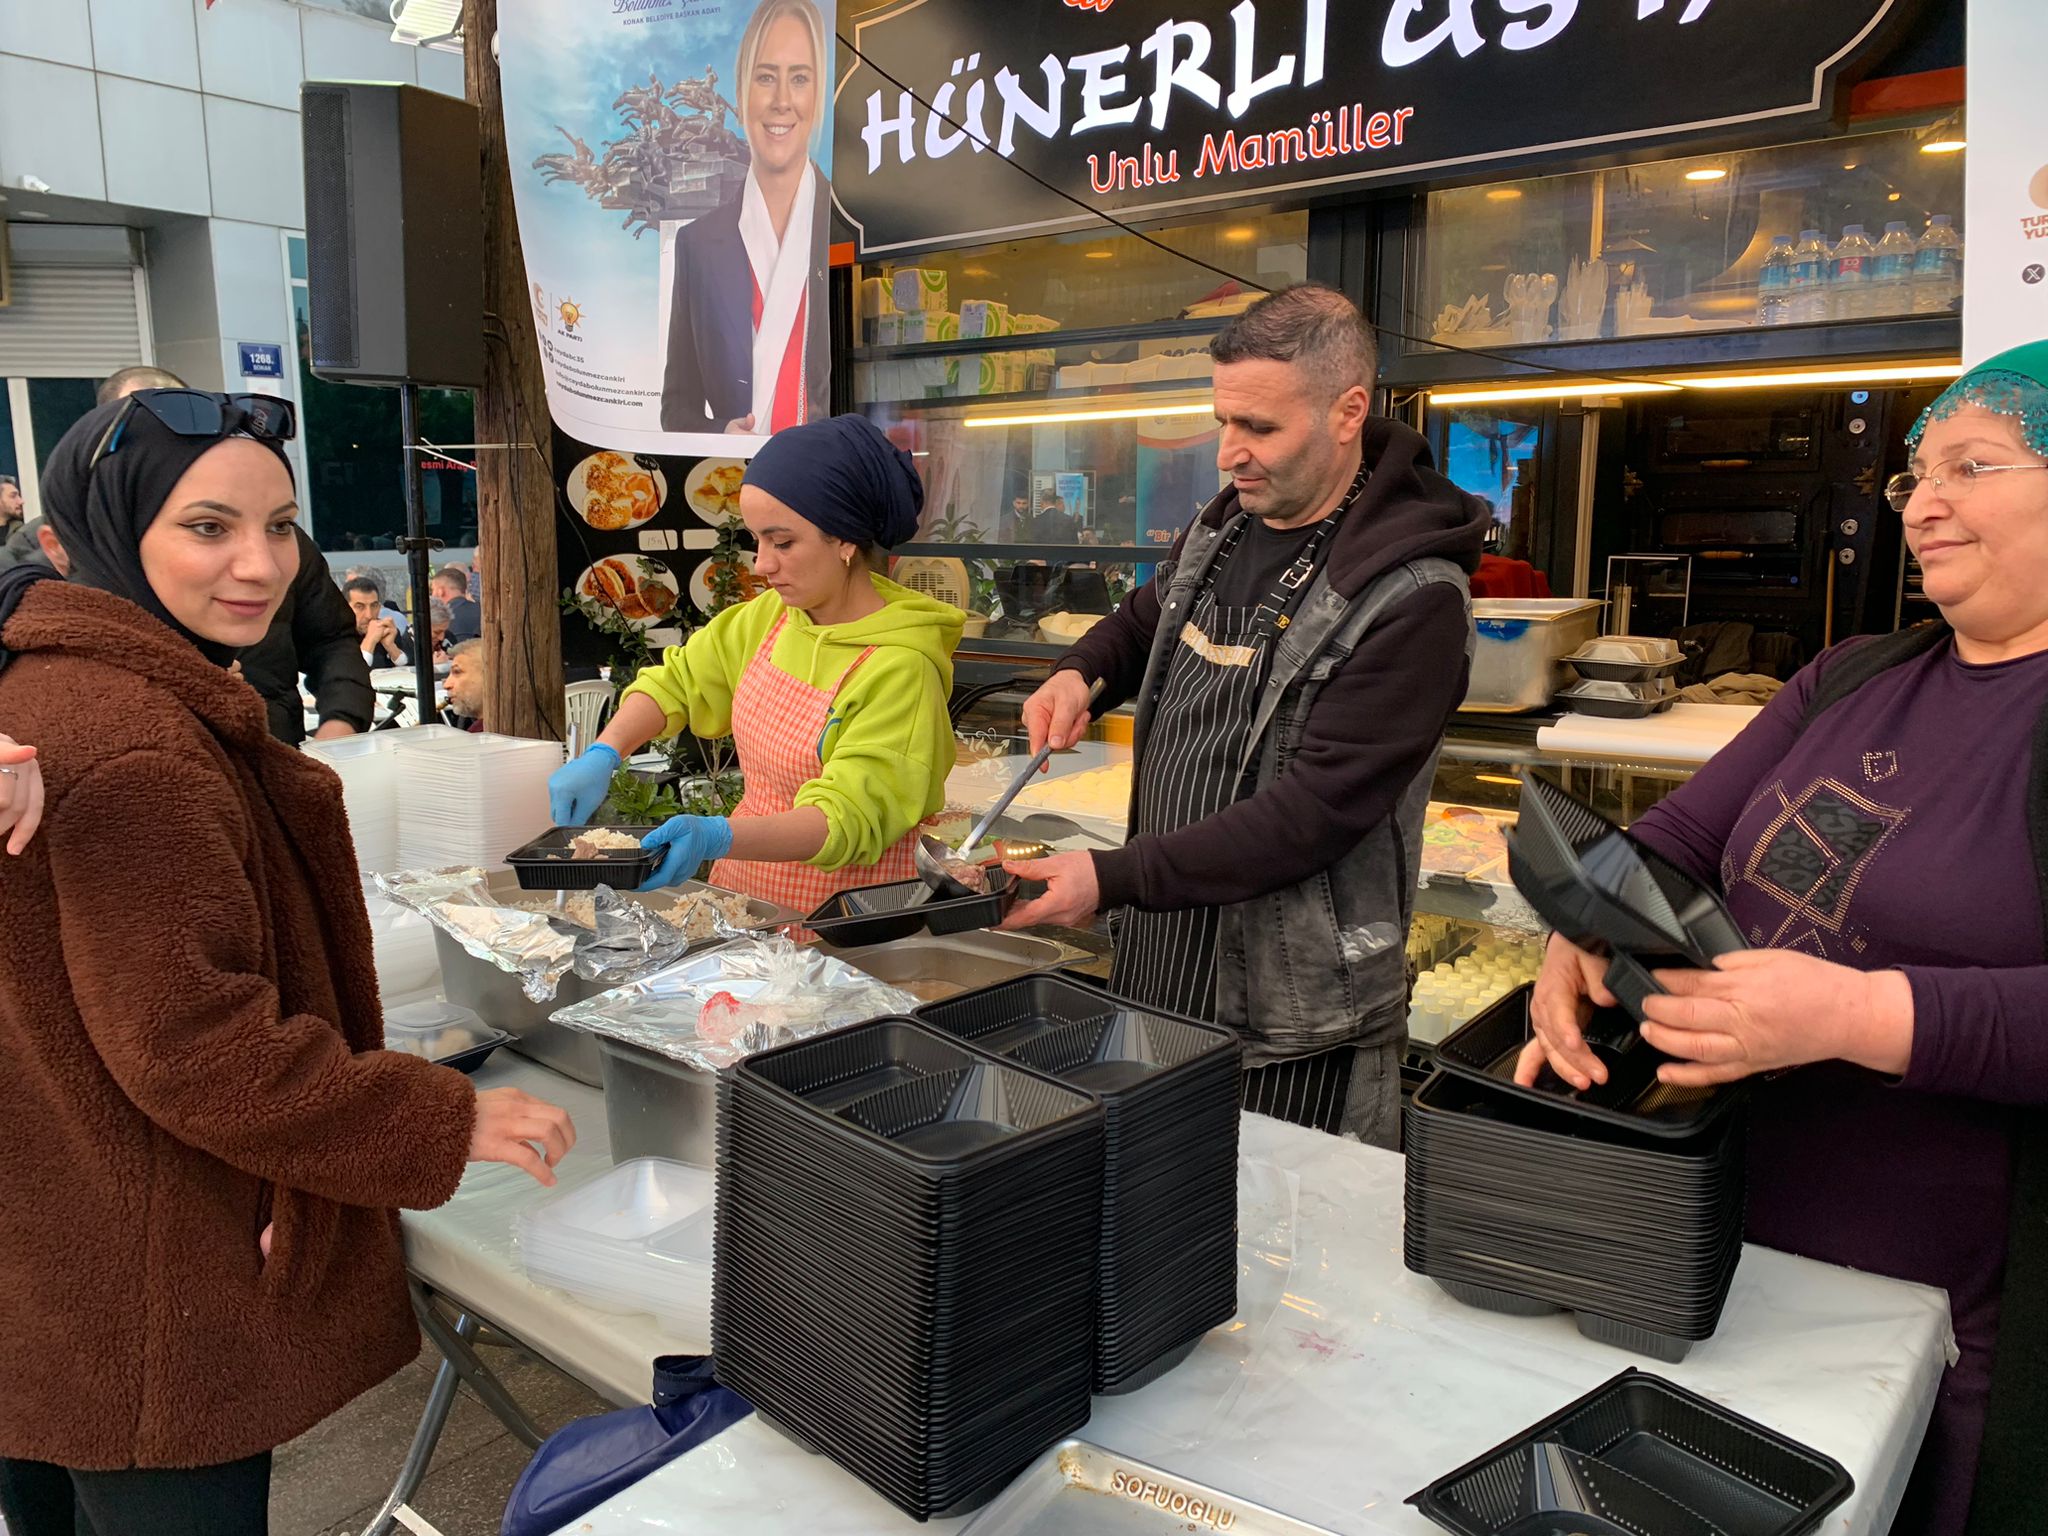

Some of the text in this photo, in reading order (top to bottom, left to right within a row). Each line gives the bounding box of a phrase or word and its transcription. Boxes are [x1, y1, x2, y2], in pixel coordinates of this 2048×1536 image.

[623, 18, 645, 26] KONAK
[1087, 103, 1414, 194] Unlu Mamüller
[1112, 1470, 1237, 1531] SOFUOGLU
